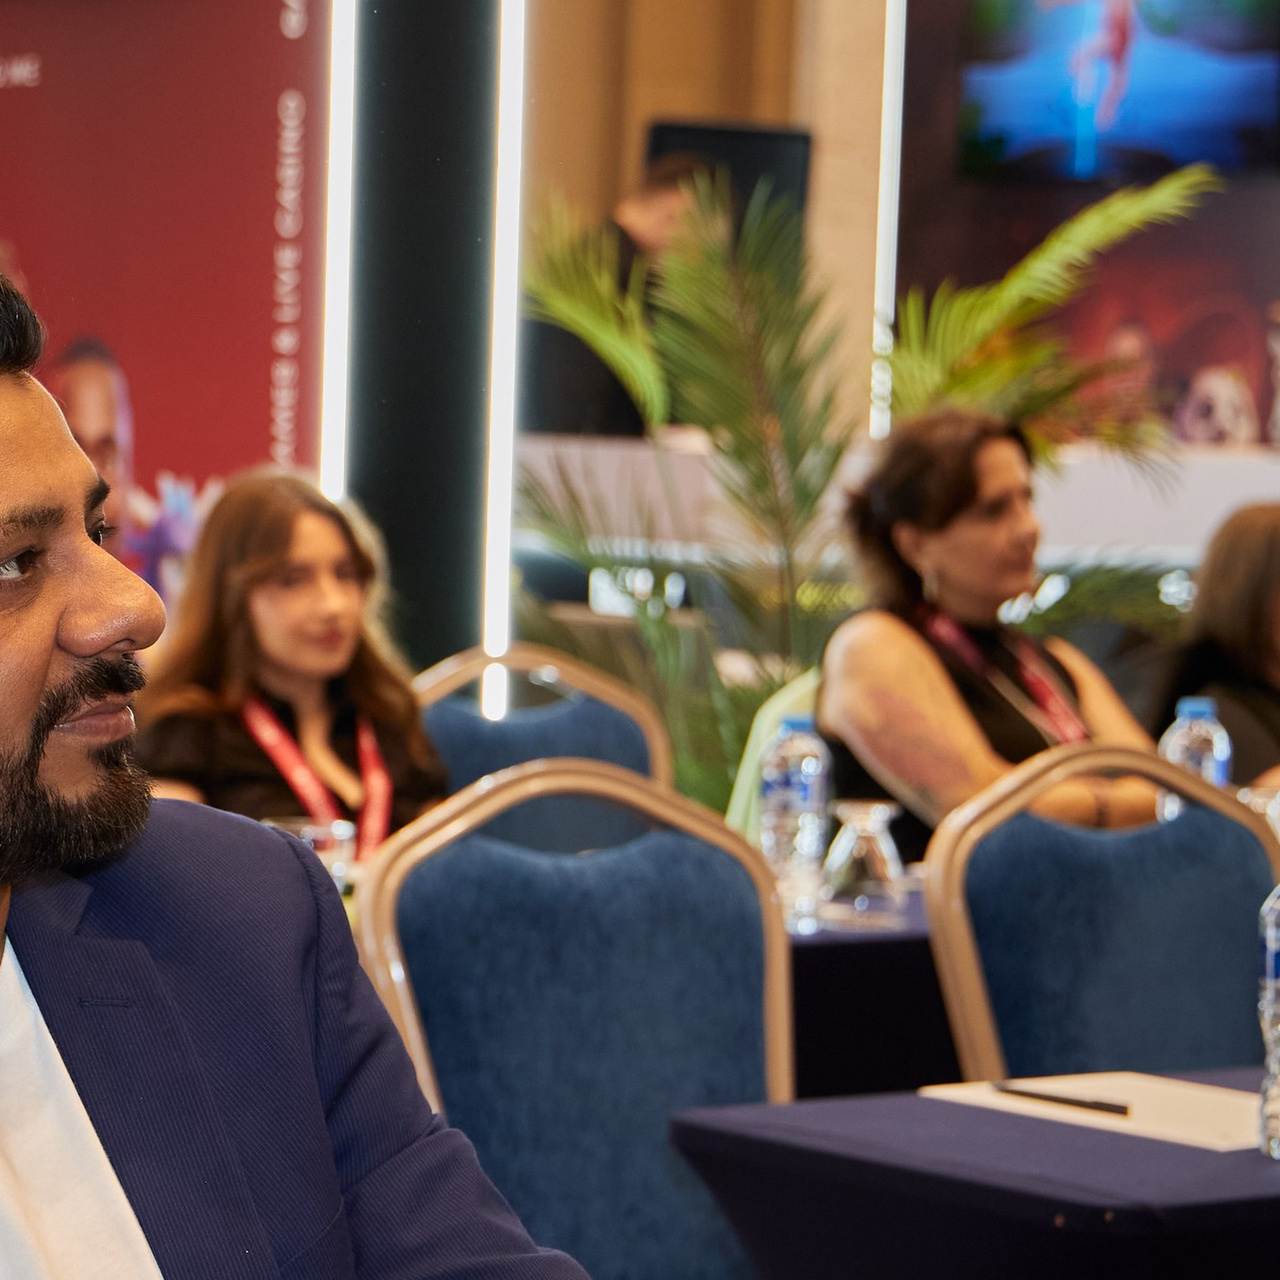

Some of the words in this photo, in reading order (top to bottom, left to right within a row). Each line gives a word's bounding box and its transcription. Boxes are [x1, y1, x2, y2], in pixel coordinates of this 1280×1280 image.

[275, 89, 306, 238] CASINO
[273, 240, 302, 322] LIVE
[269, 357, 299, 465] AMES
